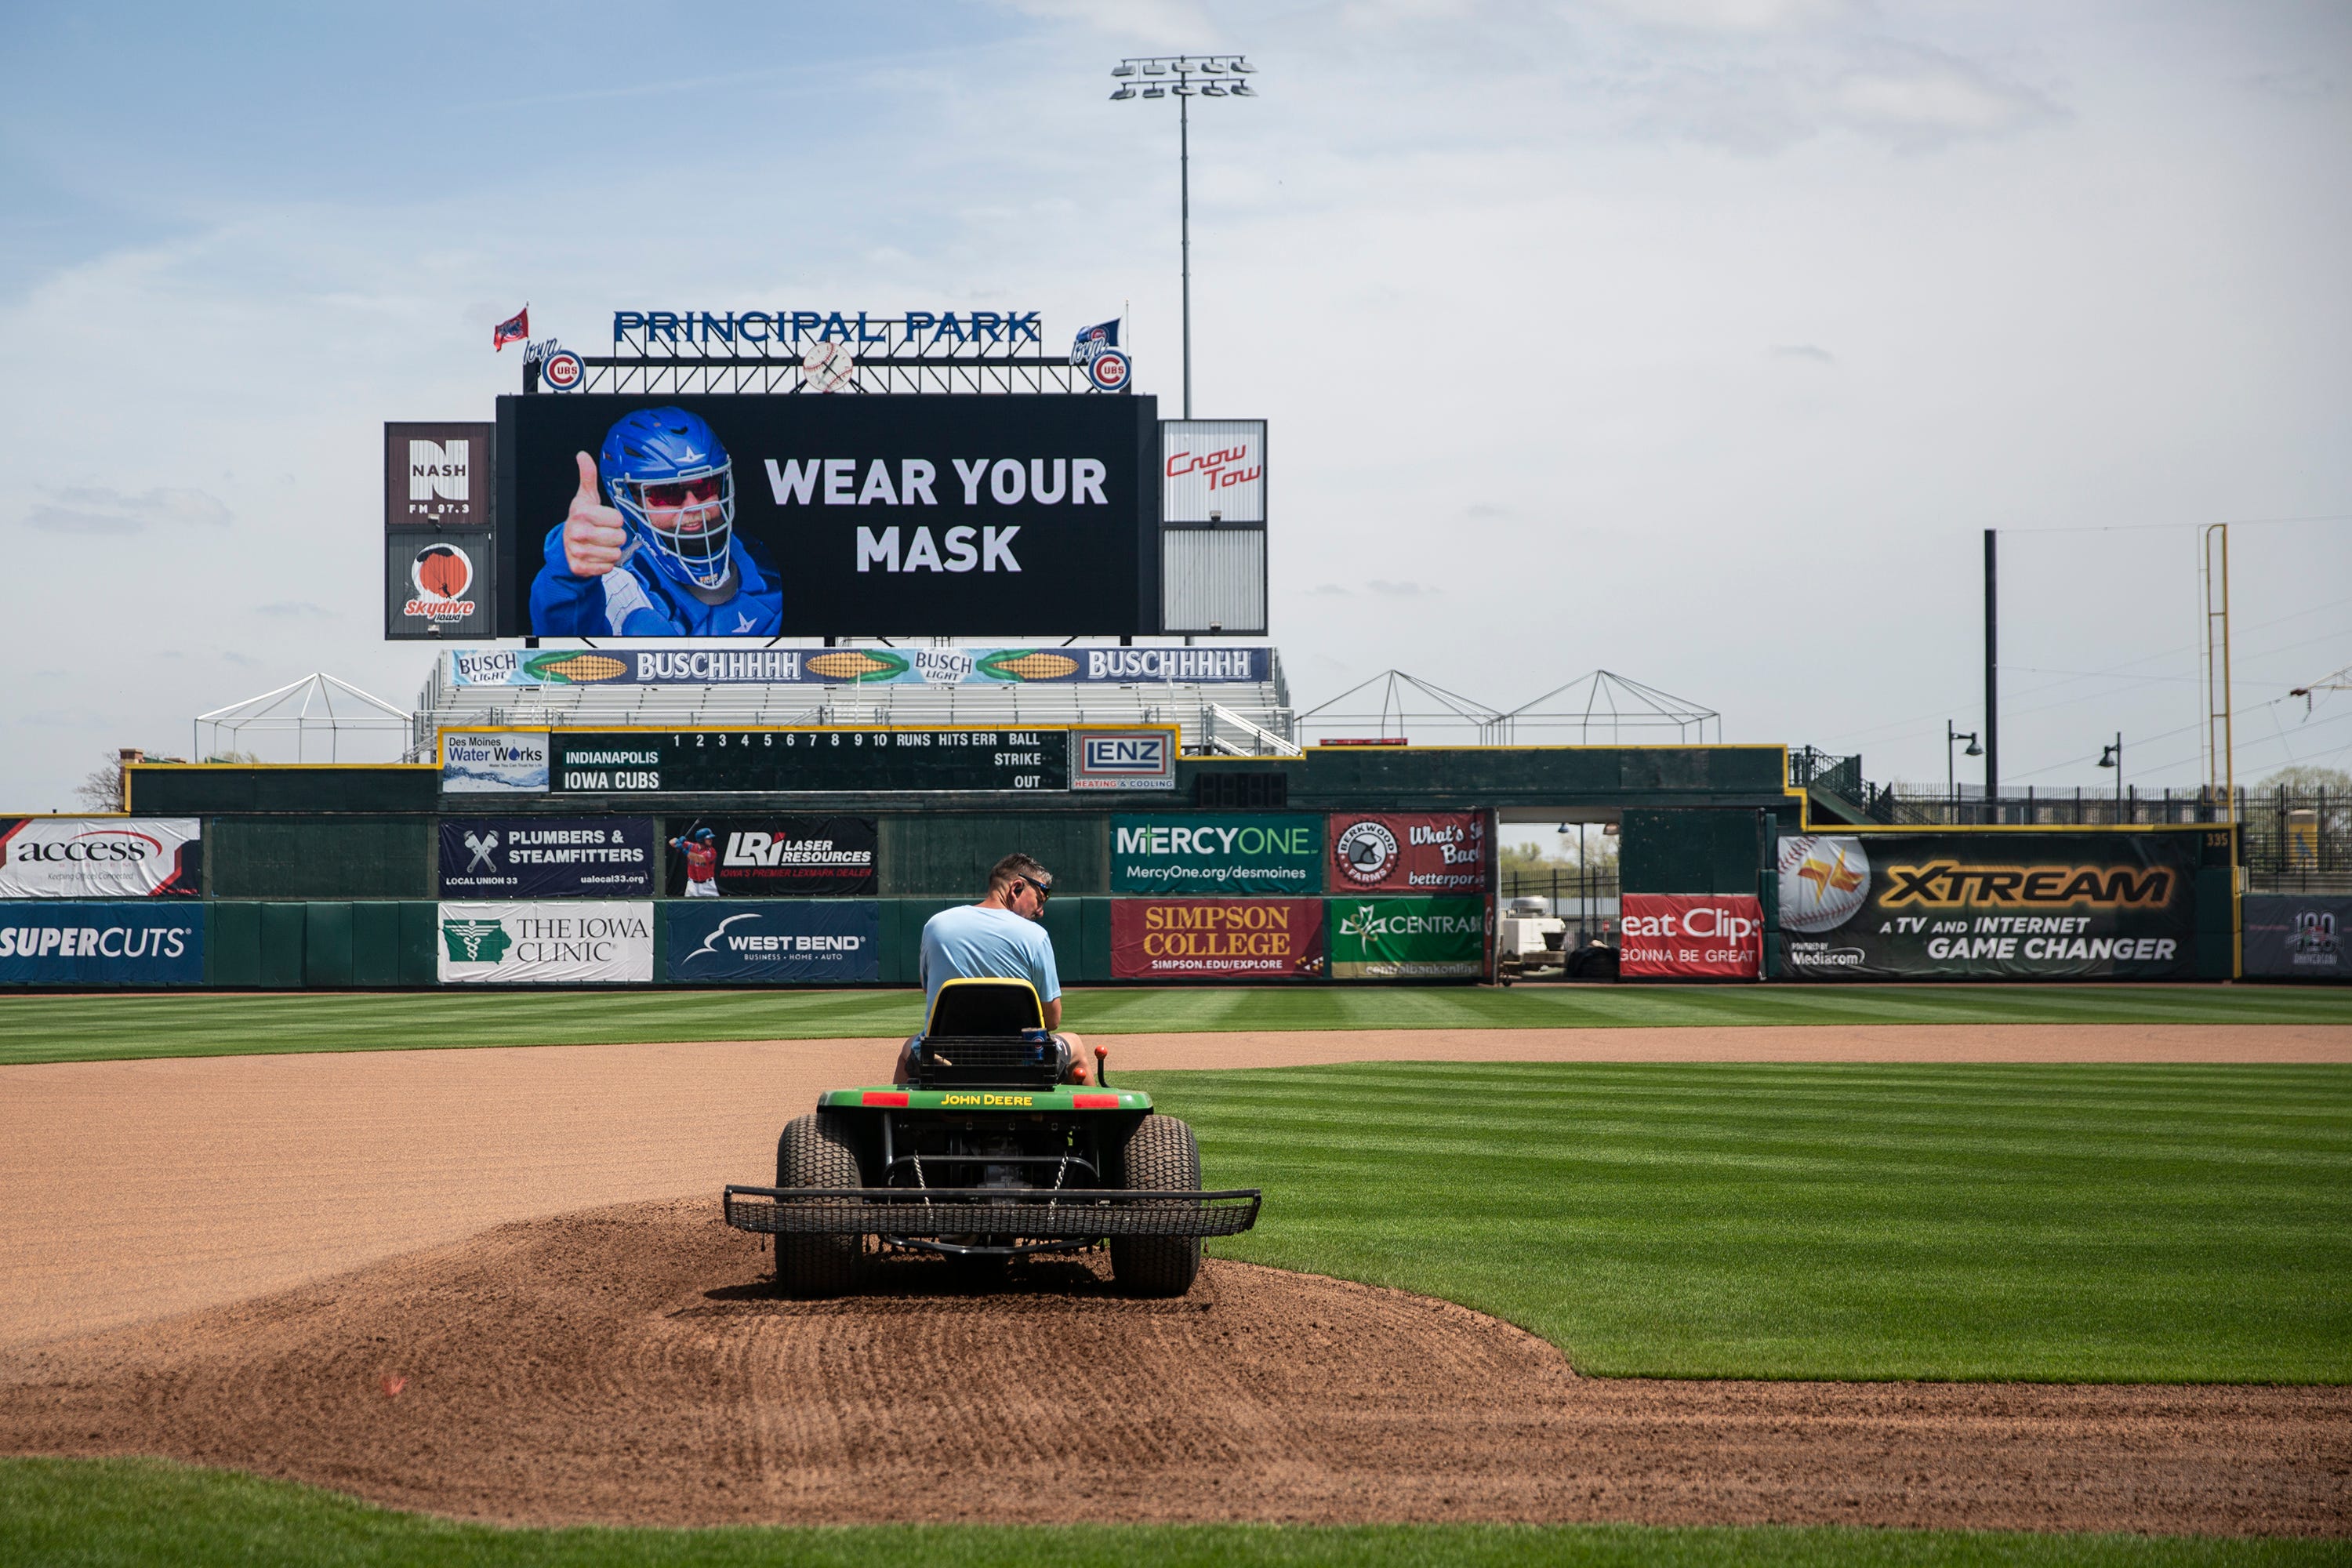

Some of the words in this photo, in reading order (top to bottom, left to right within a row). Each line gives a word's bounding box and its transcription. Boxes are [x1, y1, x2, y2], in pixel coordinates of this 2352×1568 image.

[614, 311, 886, 342] PRINCIPAL
[906, 311, 1041, 342] PARK
[524, 337, 561, 364] Iowa
[548, 356, 578, 384] CUBS
[1096, 356, 1124, 384] CUBS
[412, 464, 466, 477] NASH
[1203, 464, 1261, 490] Tow
[764, 459, 938, 505] WEAR
[952, 459, 1109, 504] YOUR
[409, 504, 428, 514] FM
[437, 504, 470, 514] 97.3
[857, 526, 1022, 572] MASK
[405, 601, 474, 617] Skydive
[459, 653, 517, 675] BUSCH
[637, 652, 800, 681] BUSCHHHHH
[915, 652, 972, 674] BUSCH
[1088, 650, 1252, 679] BUSCHHHHH
[473, 671, 506, 682] LIGHT
[926, 670, 958, 681] LIGHT
[674, 735, 679, 746] 1
[696, 735, 704, 746] 2
[719, 735, 726, 746] 3
[741, 735, 749, 746] 4
[764, 735, 771, 746] 5
[786, 734, 795, 746] 6
[809, 734, 817, 746] 7
[831, 734, 840, 746] 8
[855, 734, 862, 746] 9
[873, 734, 887, 746] 10
[897, 733, 931, 746] RUNS
[939, 733, 968, 746] HITS
[972, 733, 997, 746] ERR
[1009, 733, 1040, 746] BALL
[449, 747, 490, 760] Water
[566, 751, 659, 764] INDIANAPOLIS
[994, 753, 1041, 765] STRIKE
[1087, 742, 1160, 768] LENZ
[564, 771, 608, 789] IOWA
[615, 771, 659, 789] CUBS
[1014, 775, 1040, 788] OUT
[509, 830, 605, 844] PLUMBERS
[612, 829, 624, 844] &
[1341, 823, 1395, 852] BERKWOOD
[1410, 826, 1465, 845] What's
[2207, 833, 2228, 847] 335
[18, 841, 145, 862] access
[785, 840, 833, 851] LASER
[509, 848, 644, 863] STEAMFITTERS
[782, 851, 871, 862] RESOURCES
[581, 874, 644, 884] ualocal33.org
[720, 869, 750, 877] IOWA'S
[752, 869, 791, 877] PREMIER
[793, 869, 834, 877] LEXMARK
[836, 869, 872, 877] DEALER
[1127, 865, 1306, 882] MercyOne.org/desmoines
[1348, 868, 1388, 882] FARMS
[1882, 862, 2172, 906] XTREAM
[1145, 906, 1290, 929] SIMPSON
[1880, 922, 1892, 934] A
[1896, 917, 1928, 934] TV
[1932, 921, 1968, 934] AND
[1974, 917, 2091, 934] INTERNET
[517, 919, 572, 938] THE
[578, 918, 649, 938] IOWA
[728, 936, 793, 950] WEST
[1143, 933, 1290, 956] COLLEGE
[1927, 938, 2018, 960] GAME
[2024, 938, 2177, 960] CHANGER
[1679, 949, 1700, 962] BE
[1705, 949, 1755, 963] GREAT
[1792, 951, 1858, 965] Mediacom
[1152, 960, 1283, 969] SIMPSON.EDU/EXPLORE
[941, 1094, 980, 1105] JOHN
[984, 1094, 1033, 1105] DEERE
